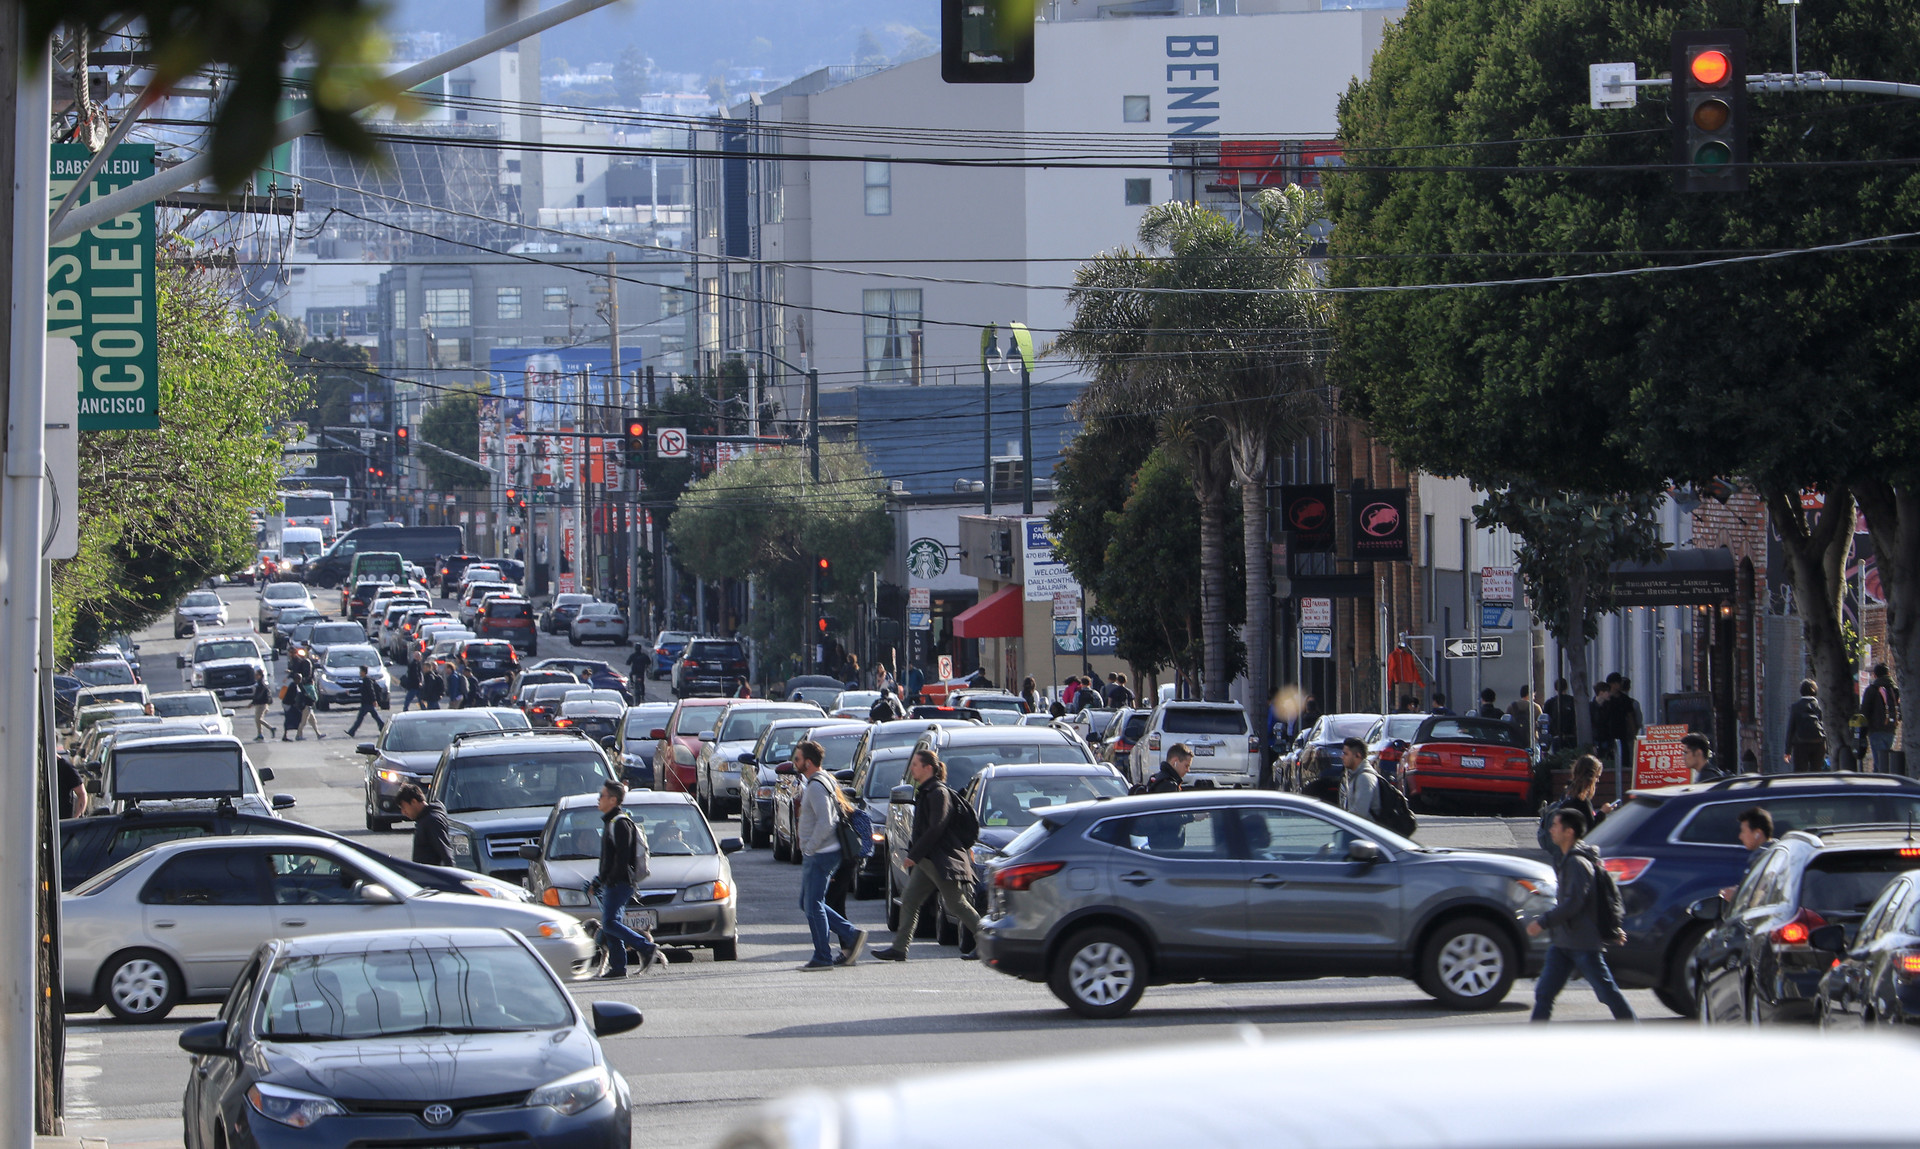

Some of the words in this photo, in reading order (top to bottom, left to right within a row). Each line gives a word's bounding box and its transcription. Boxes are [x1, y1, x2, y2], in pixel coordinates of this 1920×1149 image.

[1166, 35, 1219, 163] BENN
[50, 160, 140, 175] .BABSN.EDU
[77, 397, 146, 414] ANCISCO
[605, 441, 619, 490] MONTA
[1483, 568, 1492, 576] NO
[1091, 636, 1120, 646] OPE
